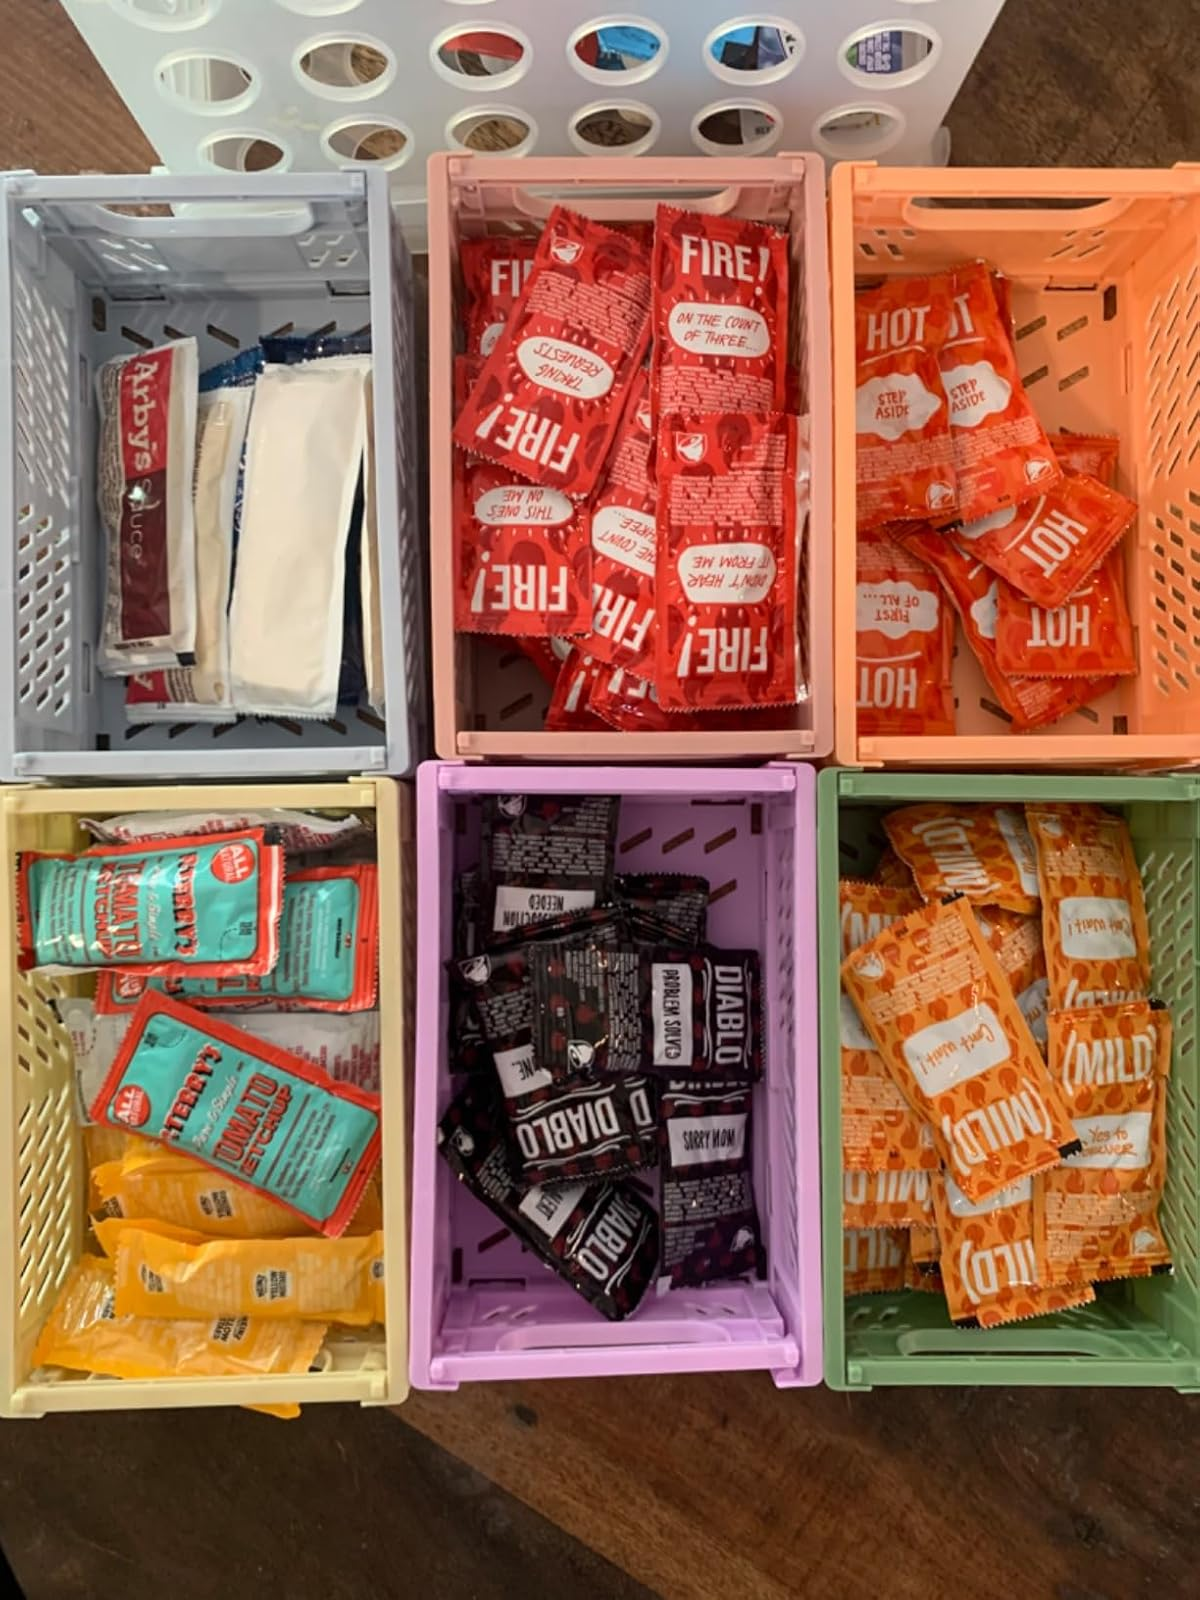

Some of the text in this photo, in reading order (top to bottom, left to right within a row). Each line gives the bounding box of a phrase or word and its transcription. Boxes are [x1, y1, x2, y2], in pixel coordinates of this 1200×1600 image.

[681, 234, 771, 297] FIRE!
[676, 312, 762, 333] ON THE COUNT
[684, 330, 702, 342] OF
[866, 304, 932, 351] HOT
[533, 341, 604, 379] REQUESTS
[535, 364, 584, 392] TAKING
[877, 389, 908, 406] STEP
[950, 379, 978, 398] STEP
[951, 390, 986, 413] ASIDE
[126, 360, 160, 472] Arby's
[875, 404, 910, 420] ASIDE
[475, 392, 581, 474] FIRE!
[503, 489, 544, 503] ON ME
[525, 506, 553, 521] THIS
[597, 529, 637, 553] COUNT
[1019, 509, 1089, 579] HOT
[687, 572, 725, 588] HEAR
[692, 554, 772, 570] IT FROM ME
[470, 550, 568, 613] FIRE!
[873, 608, 911, 623] FIRST
[904, 596, 920, 609] OF
[1026, 604, 1091, 648] HOT
[677, 614, 768, 678] FIRE!
[856, 666, 918, 709] HOT
[230, 845, 249, 881] ALL
[111, 860, 147, 958] TOMATO
[528, 893, 565, 912] NEEDED
[662, 968, 681, 1017] PROBLEM
[714, 965, 745, 1065] DIABLO
[113, 1088, 137, 1124] ALL
[515, 1095, 621, 1160] DIABLO
[682, 1128, 736, 1151] SORRY MOM
[942, 1077, 1054, 1177] (MILD)
[577, 1190, 643, 1282] DIABLO
